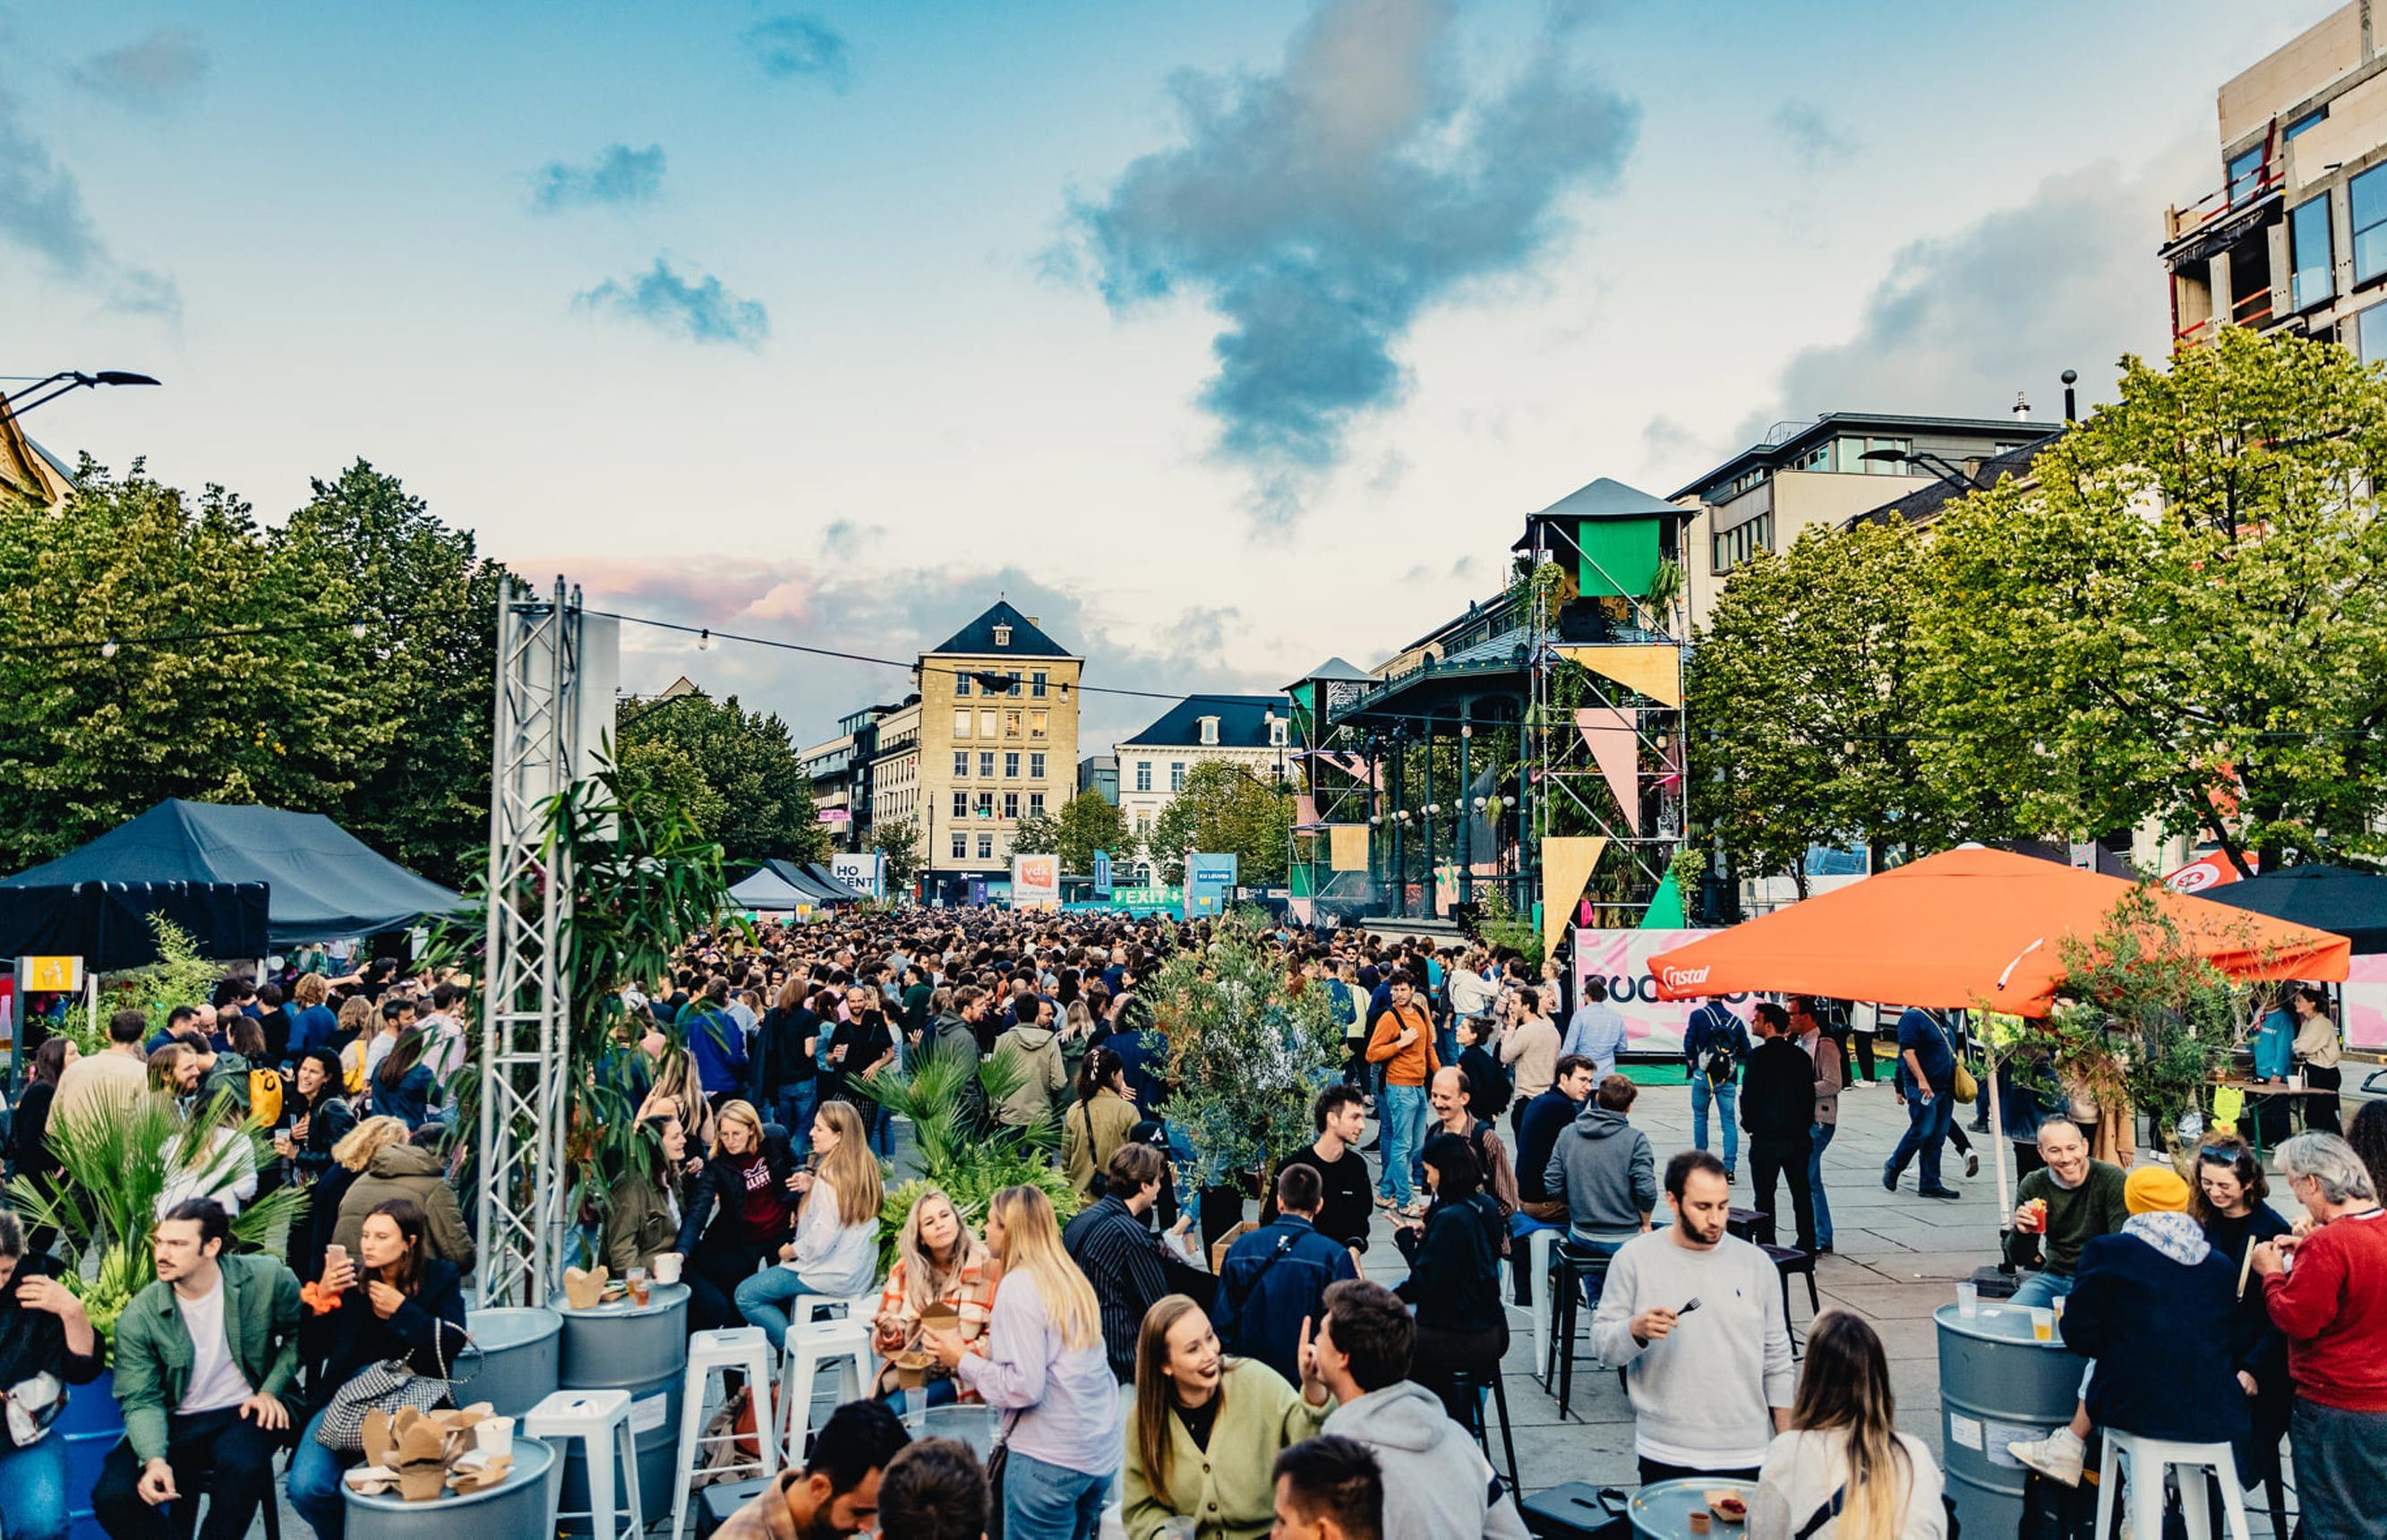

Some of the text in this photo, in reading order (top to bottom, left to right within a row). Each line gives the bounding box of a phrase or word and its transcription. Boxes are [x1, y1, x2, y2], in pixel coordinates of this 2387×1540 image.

[837, 866, 859, 876] HO
[1024, 864, 1048, 875] vdk
[1125, 890, 1167, 903] EXIT
[1663, 966, 1710, 991] Cristal
